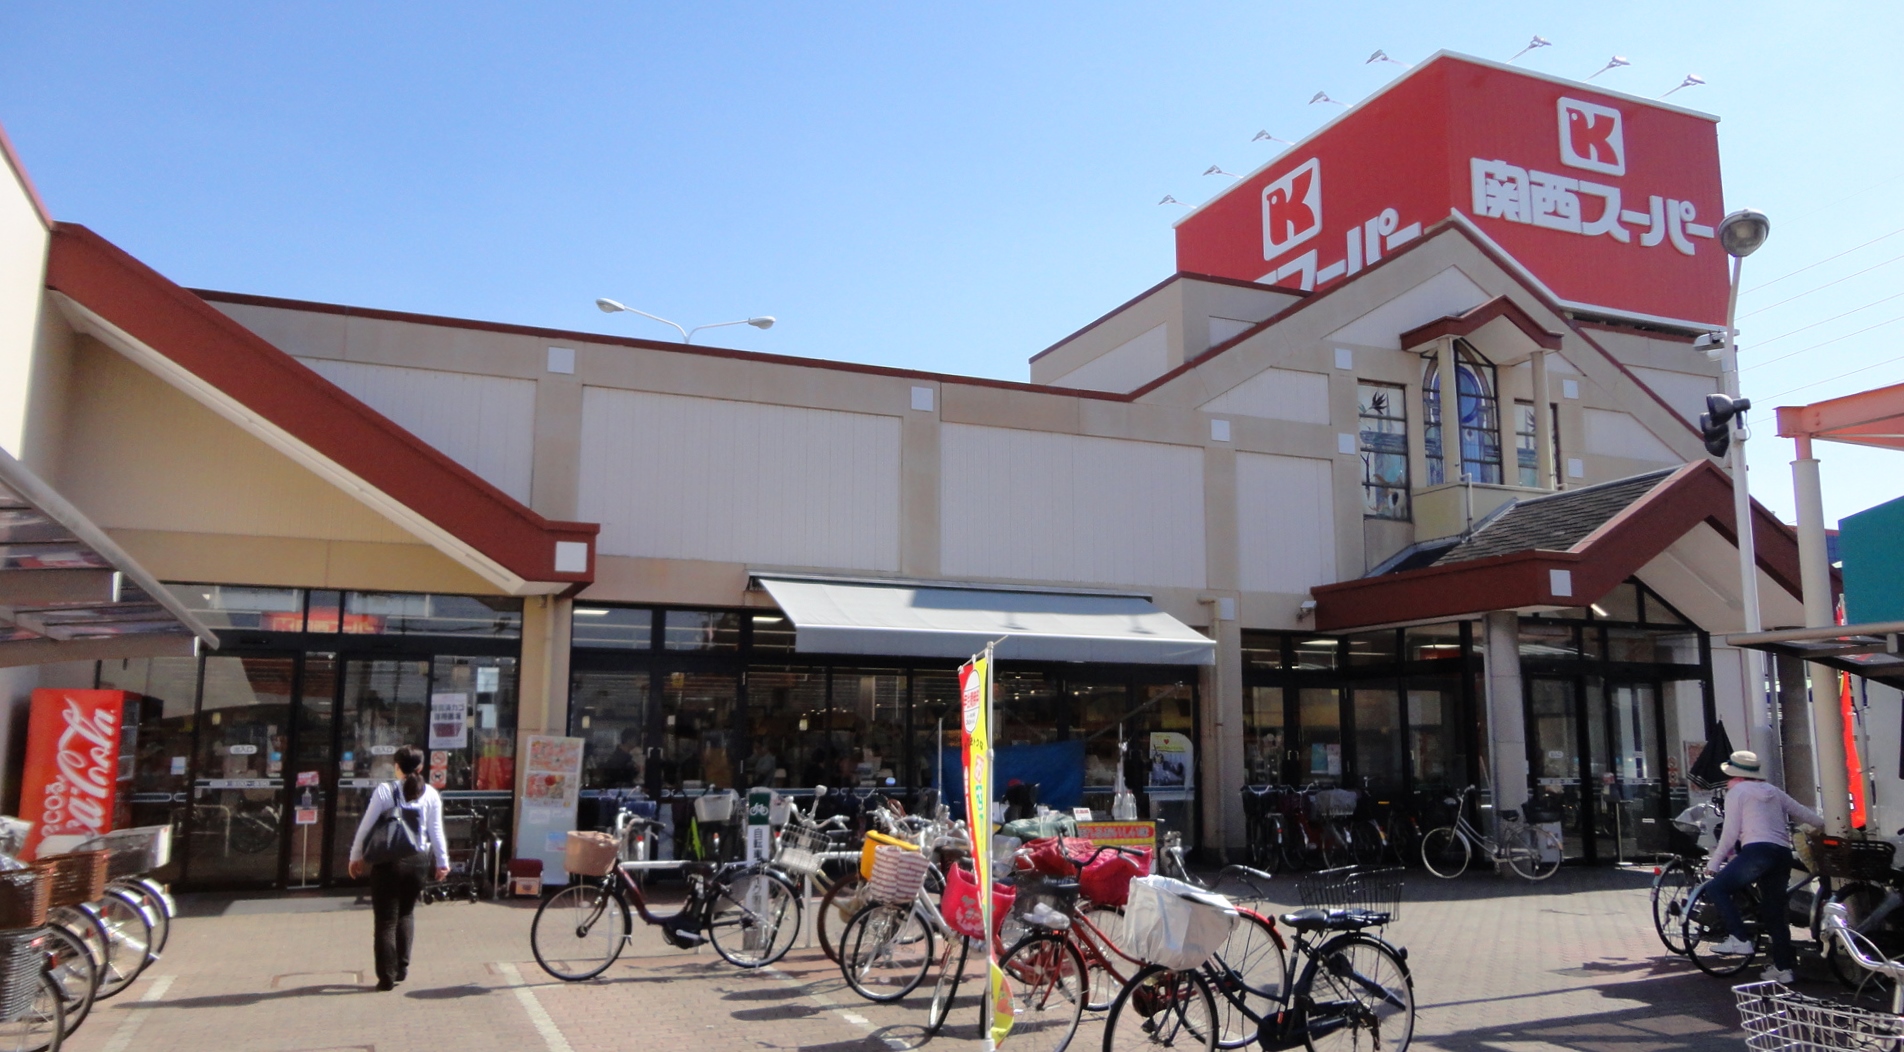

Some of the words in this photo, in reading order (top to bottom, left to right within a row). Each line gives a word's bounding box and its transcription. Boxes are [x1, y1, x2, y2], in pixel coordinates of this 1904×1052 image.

[1253, 207, 1423, 292] スーパー
[1469, 156, 1715, 256] 関西スーパー
